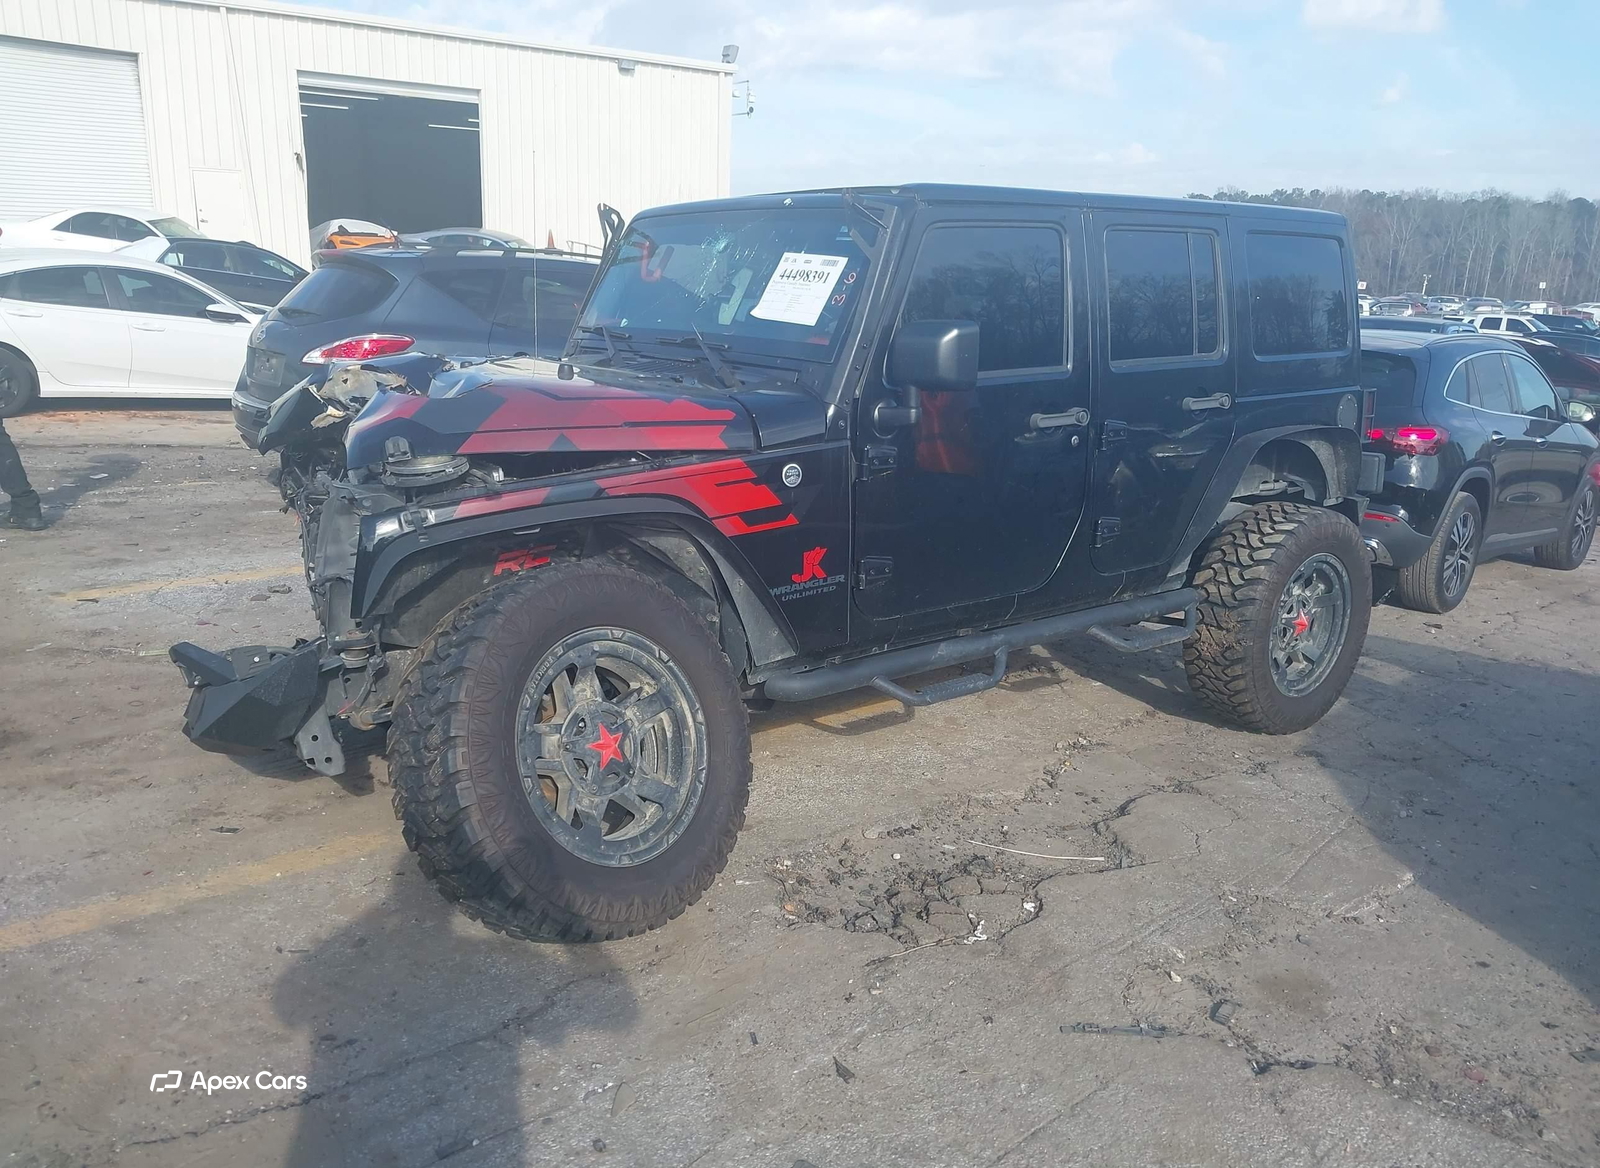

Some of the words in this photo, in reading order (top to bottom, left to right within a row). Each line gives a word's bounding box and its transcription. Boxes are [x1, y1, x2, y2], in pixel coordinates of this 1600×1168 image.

[779, 268, 830, 283] 44498391
[792, 546, 828, 583] JK
[770, 574, 846, 597] WRANGLER
[782, 585, 836, 602] UNLIMITED
